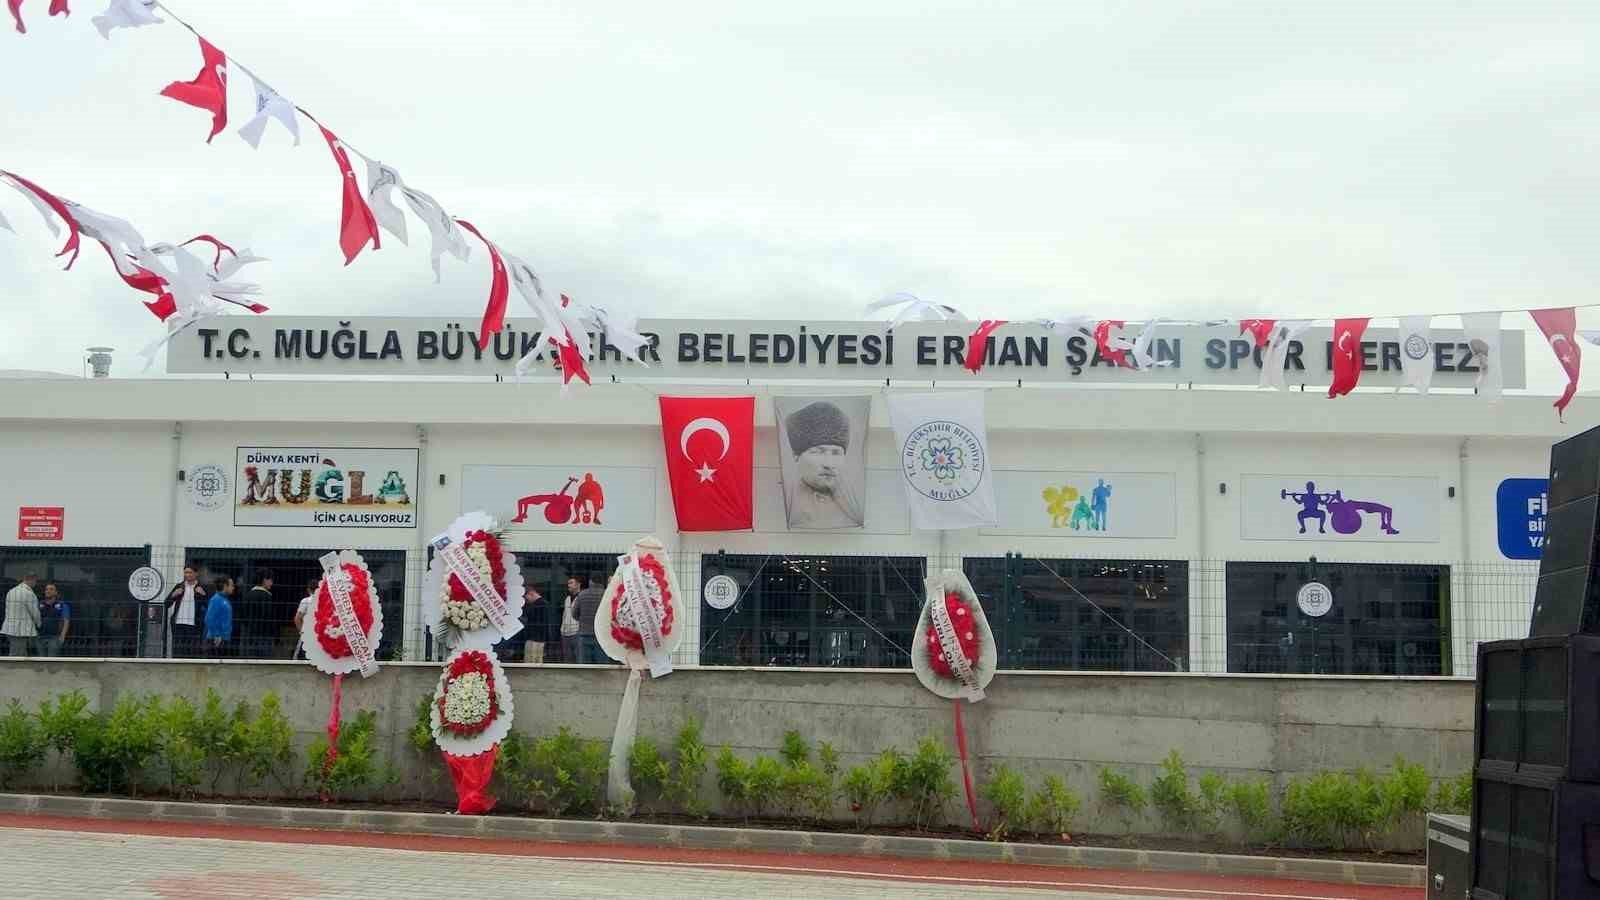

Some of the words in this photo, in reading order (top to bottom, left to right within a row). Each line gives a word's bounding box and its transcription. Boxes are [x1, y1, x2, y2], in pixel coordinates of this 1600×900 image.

[198, 328, 260, 359] T.C.
[274, 321, 403, 361] MUĞLA
[417, 323, 661, 369] BÜYÜKHR
[677, 326, 893, 366] BELEDİYESİ
[247, 452, 284, 464] DÜNYA
[287, 452, 320, 464] KENTİ
[241, 459, 411, 505] MUĞLA
[313, 511, 336, 524] İÇİN
[339, 513, 411, 525] ÇALIŞIYORUZ
